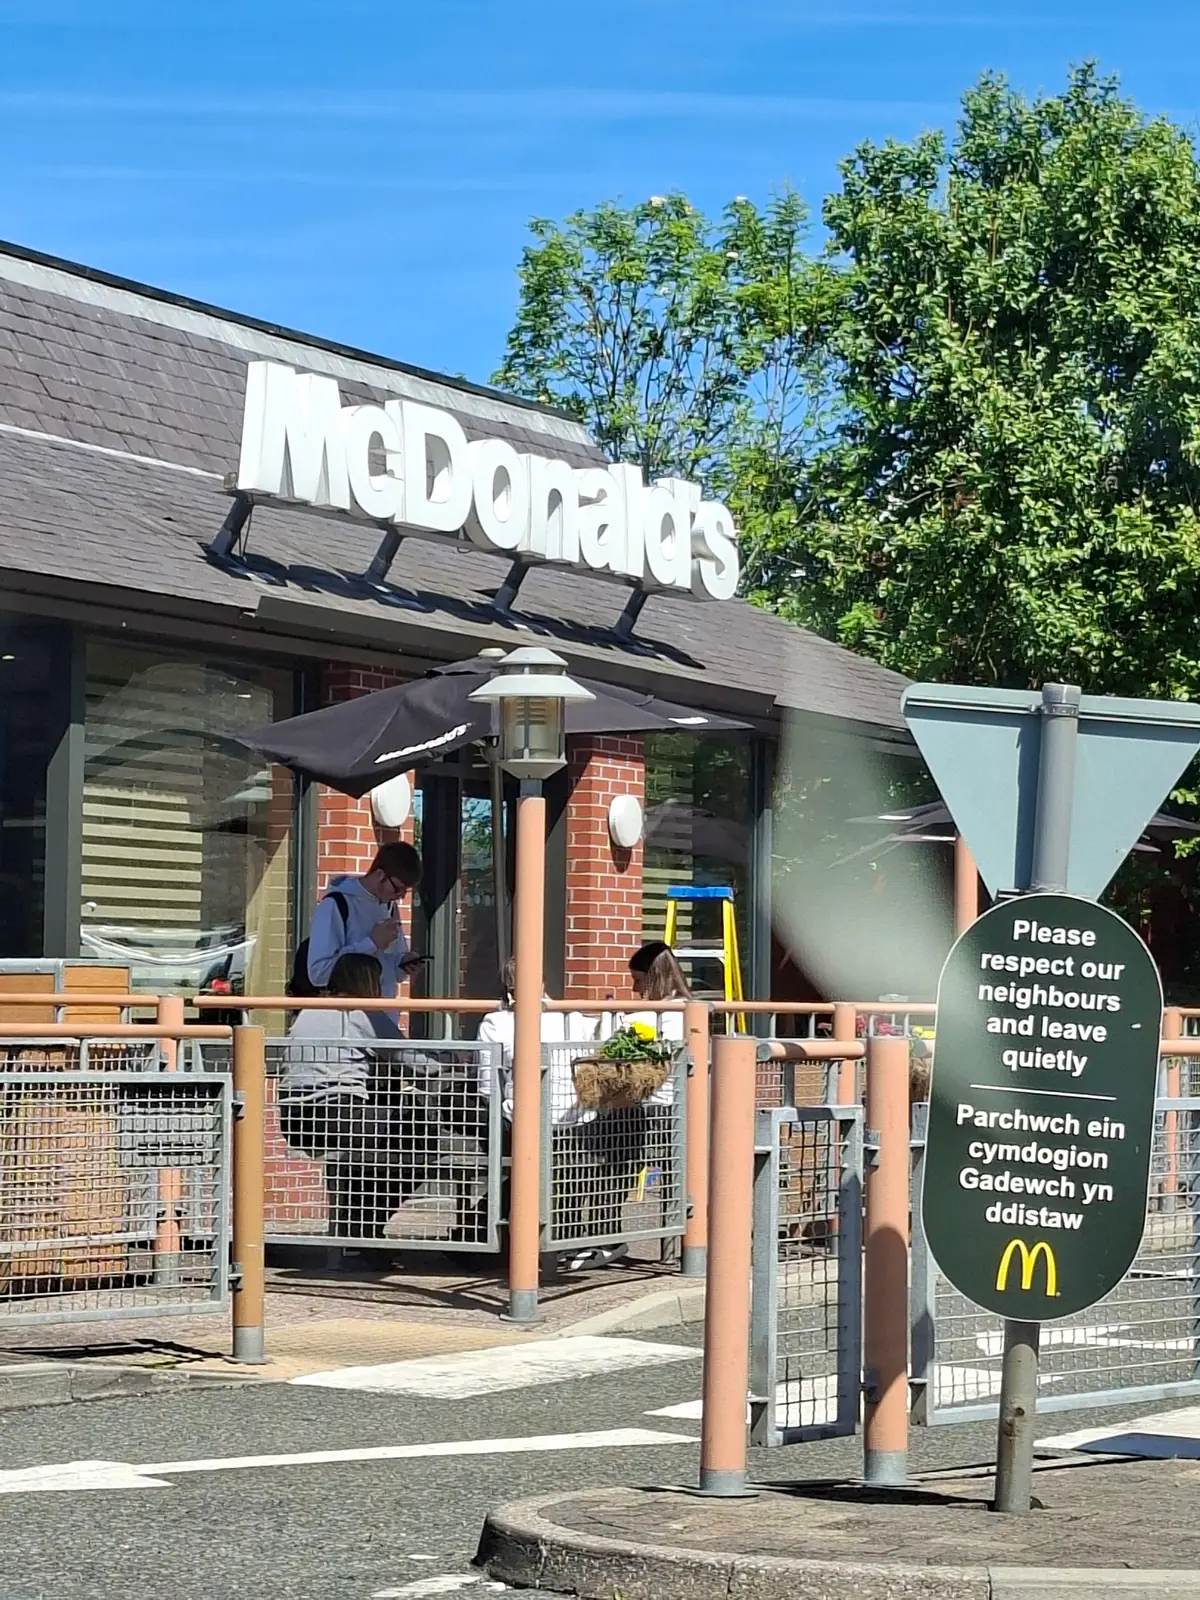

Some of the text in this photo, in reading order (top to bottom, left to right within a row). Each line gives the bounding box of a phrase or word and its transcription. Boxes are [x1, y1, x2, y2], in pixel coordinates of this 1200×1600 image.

[238, 361, 740, 600] McDonald's
[1013, 919, 1096, 947] Please
[980, 953, 1126, 980] respect our
[978, 983, 1121, 1012] neighbours
[986, 1014, 1107, 1042] and leave
[1002, 1046, 1088, 1077] quietly
[956, 1103, 1125, 1140] Parchwch ein
[968, 1140, 1109, 1170] cymdogion
[959, 1167, 1113, 1205] Gadewch yn
[985, 1203, 1083, 1230] ddistaw
